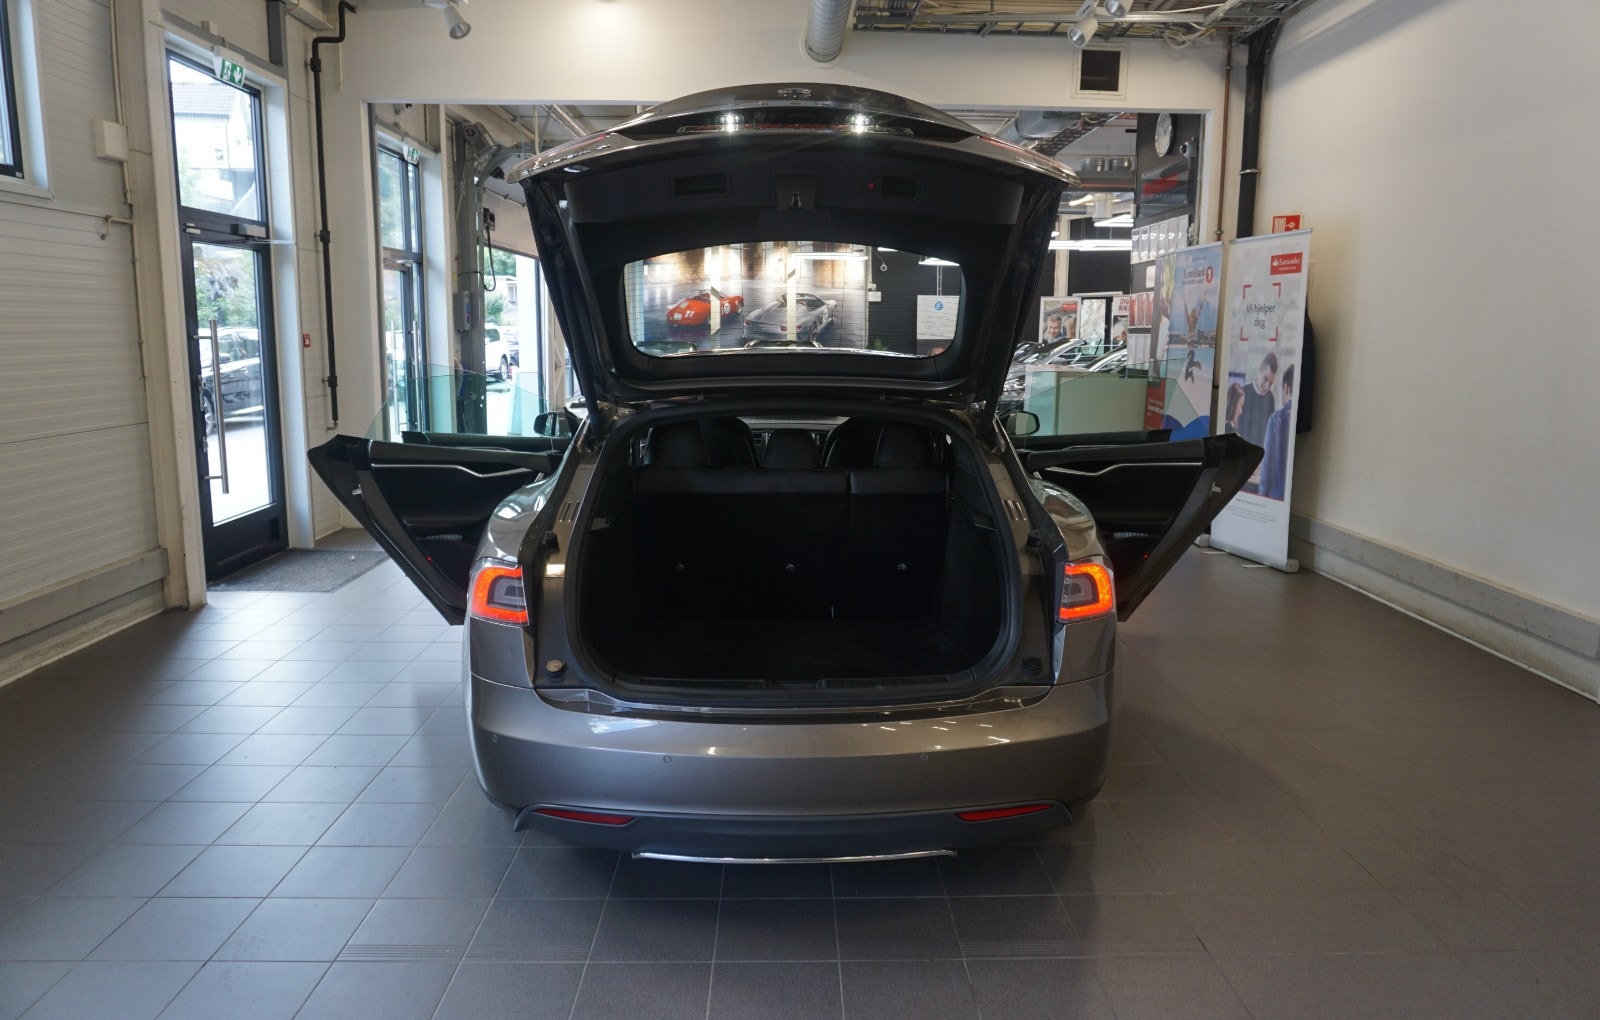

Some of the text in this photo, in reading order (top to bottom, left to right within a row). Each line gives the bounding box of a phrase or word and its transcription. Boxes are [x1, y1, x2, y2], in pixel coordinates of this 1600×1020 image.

[1246, 303, 1276, 316] Vi hjelper
[1254, 317, 1266, 330] deg
